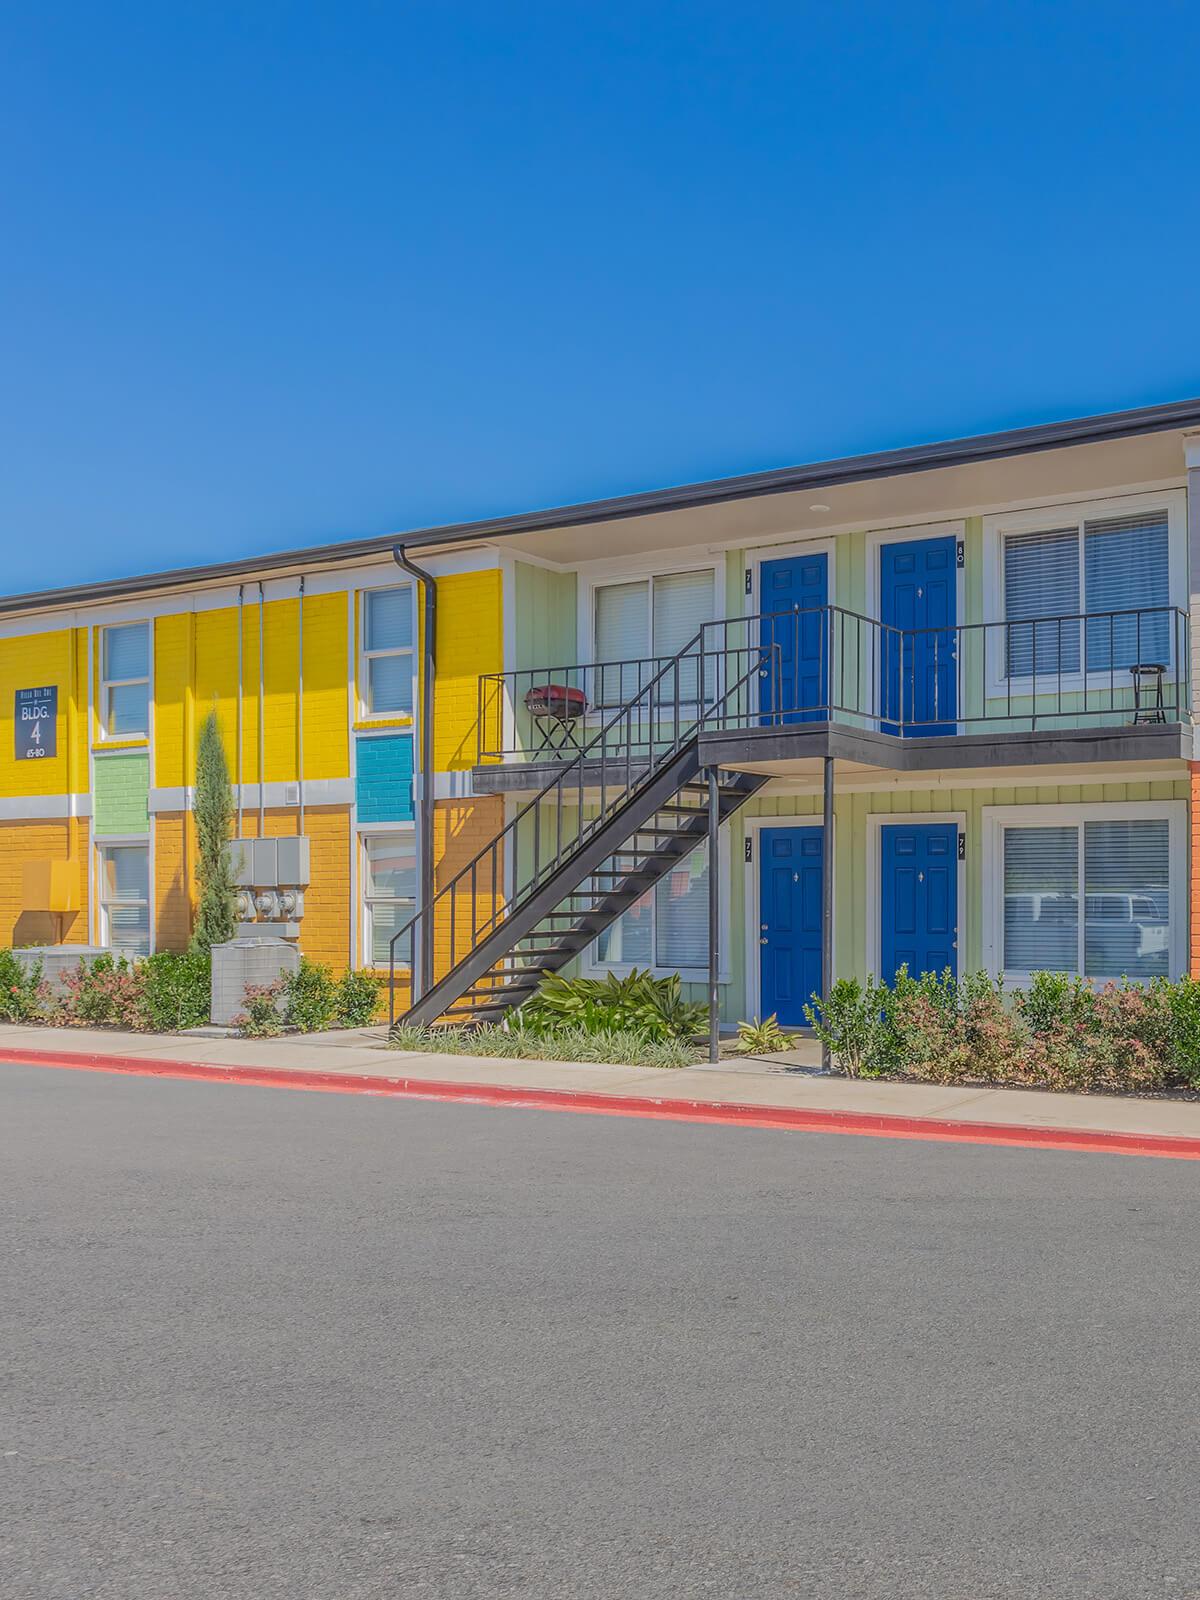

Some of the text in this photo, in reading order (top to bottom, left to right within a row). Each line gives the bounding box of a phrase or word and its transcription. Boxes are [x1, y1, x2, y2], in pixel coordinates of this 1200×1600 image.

[957, 546, 964, 562] 80
[21, 706, 50, 721] BLDG.
[30, 721, 41, 745] 4
[745, 842, 751, 857] 77
[959, 838, 964, 855] 79
